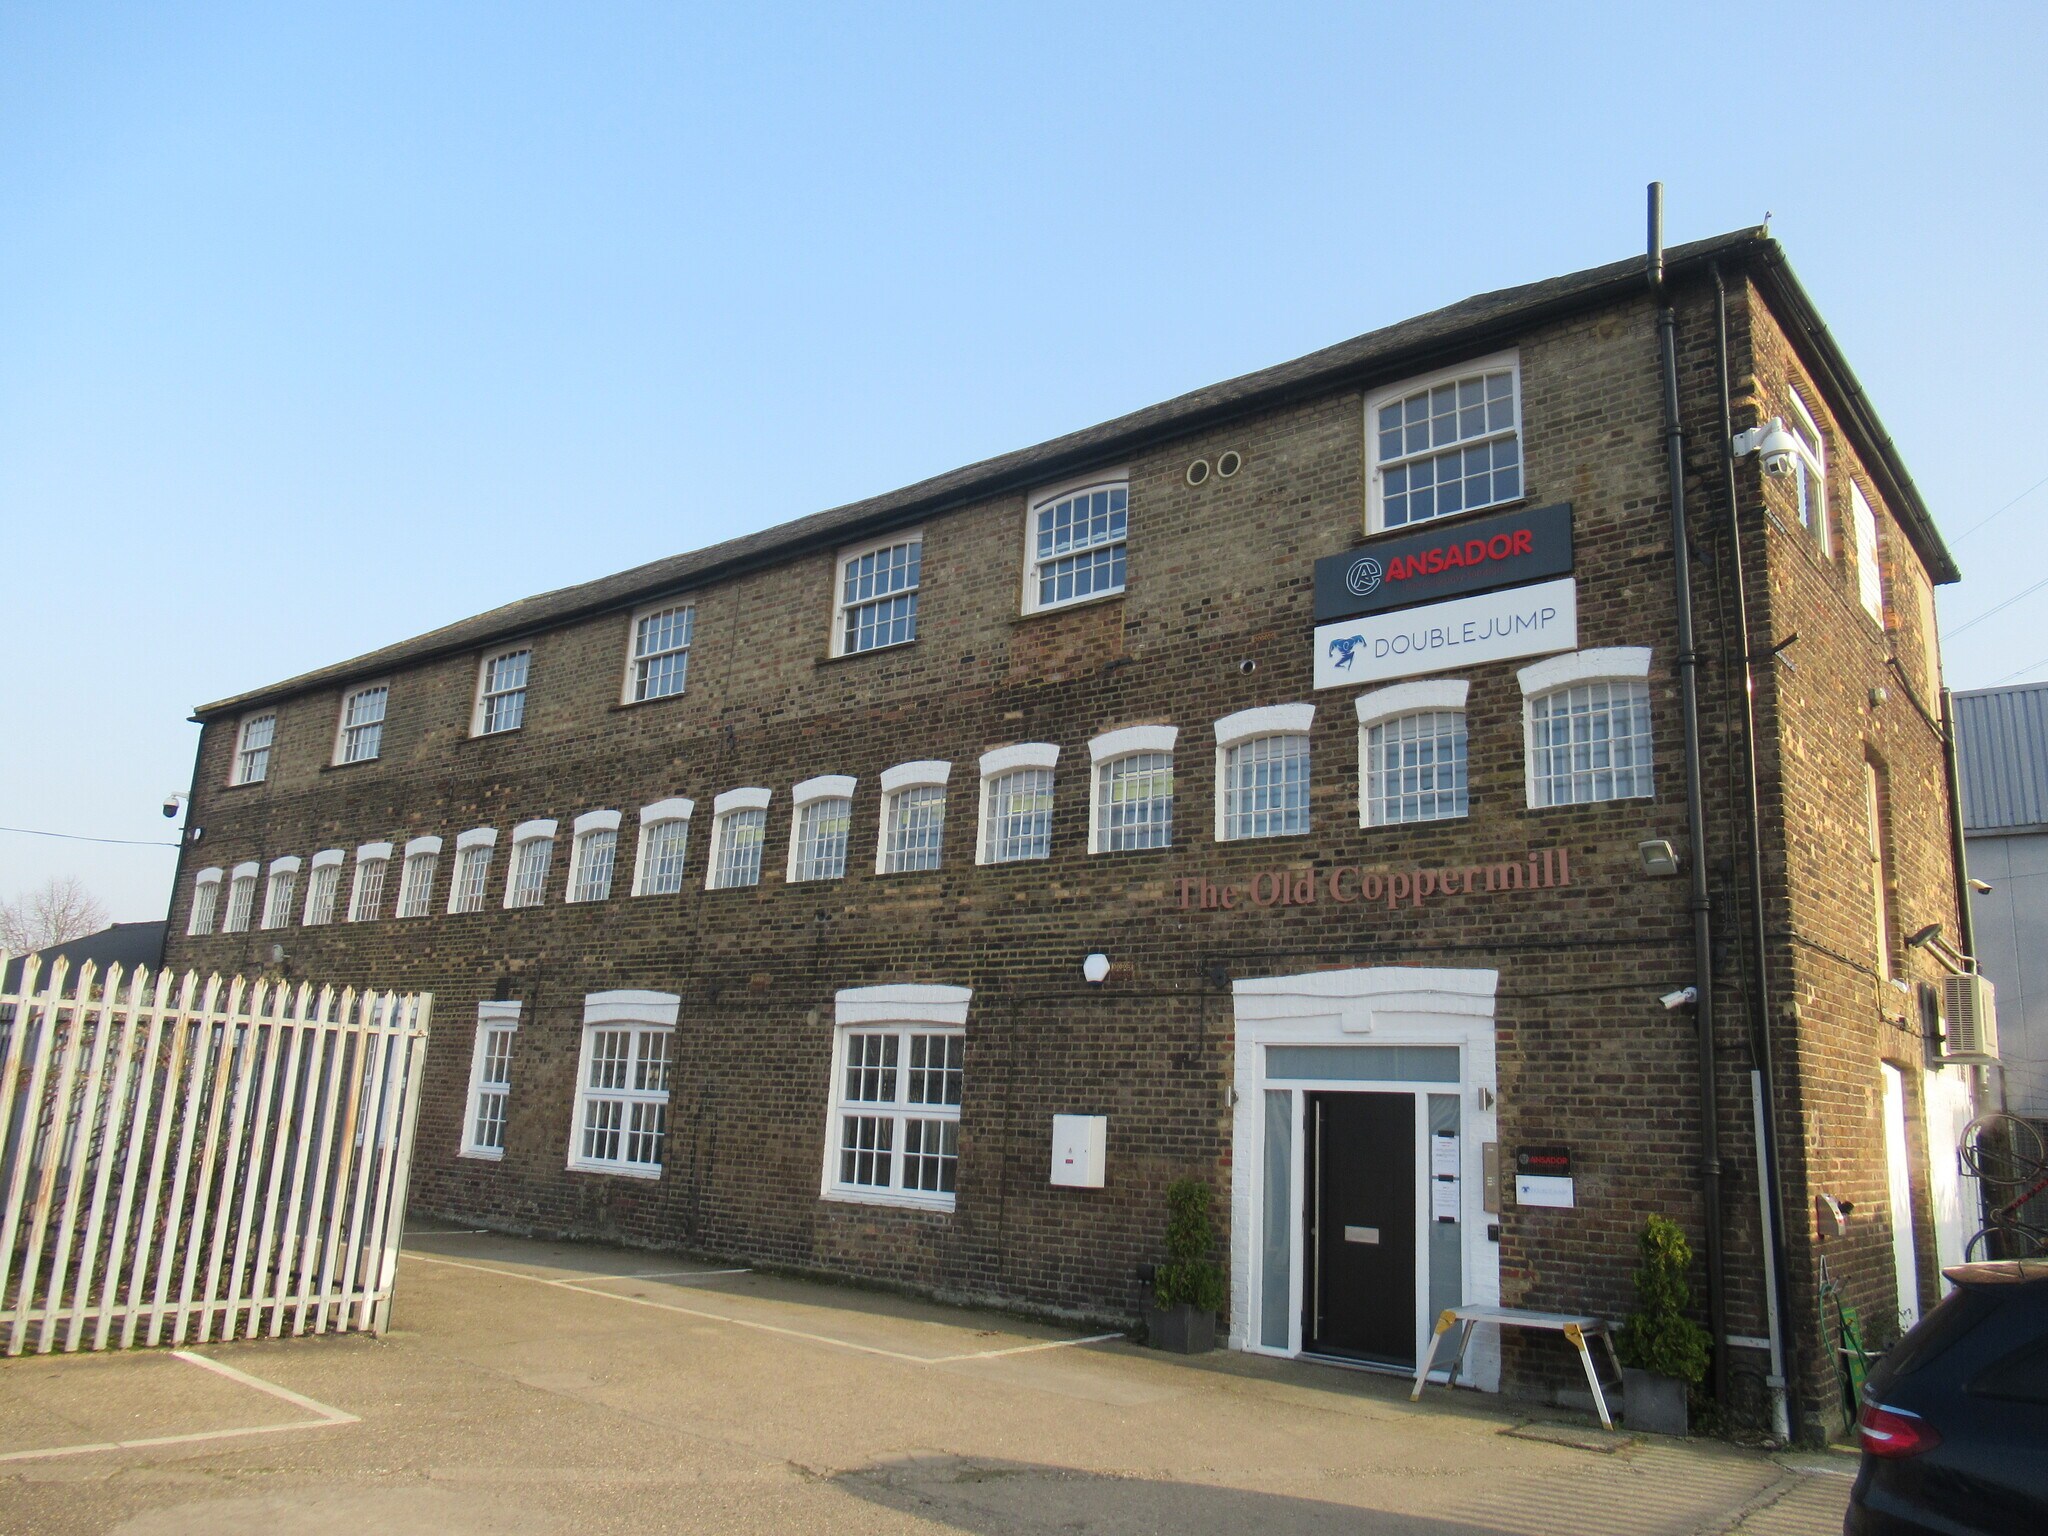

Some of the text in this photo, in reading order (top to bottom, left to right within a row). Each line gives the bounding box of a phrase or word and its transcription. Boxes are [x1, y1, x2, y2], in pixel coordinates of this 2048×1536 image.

[1385, 529, 1533, 583] ANSADOR
[1374, 607, 1556, 658] DOUBLEJUMP
[1172, 848, 1571, 910] The Old Coppermill
